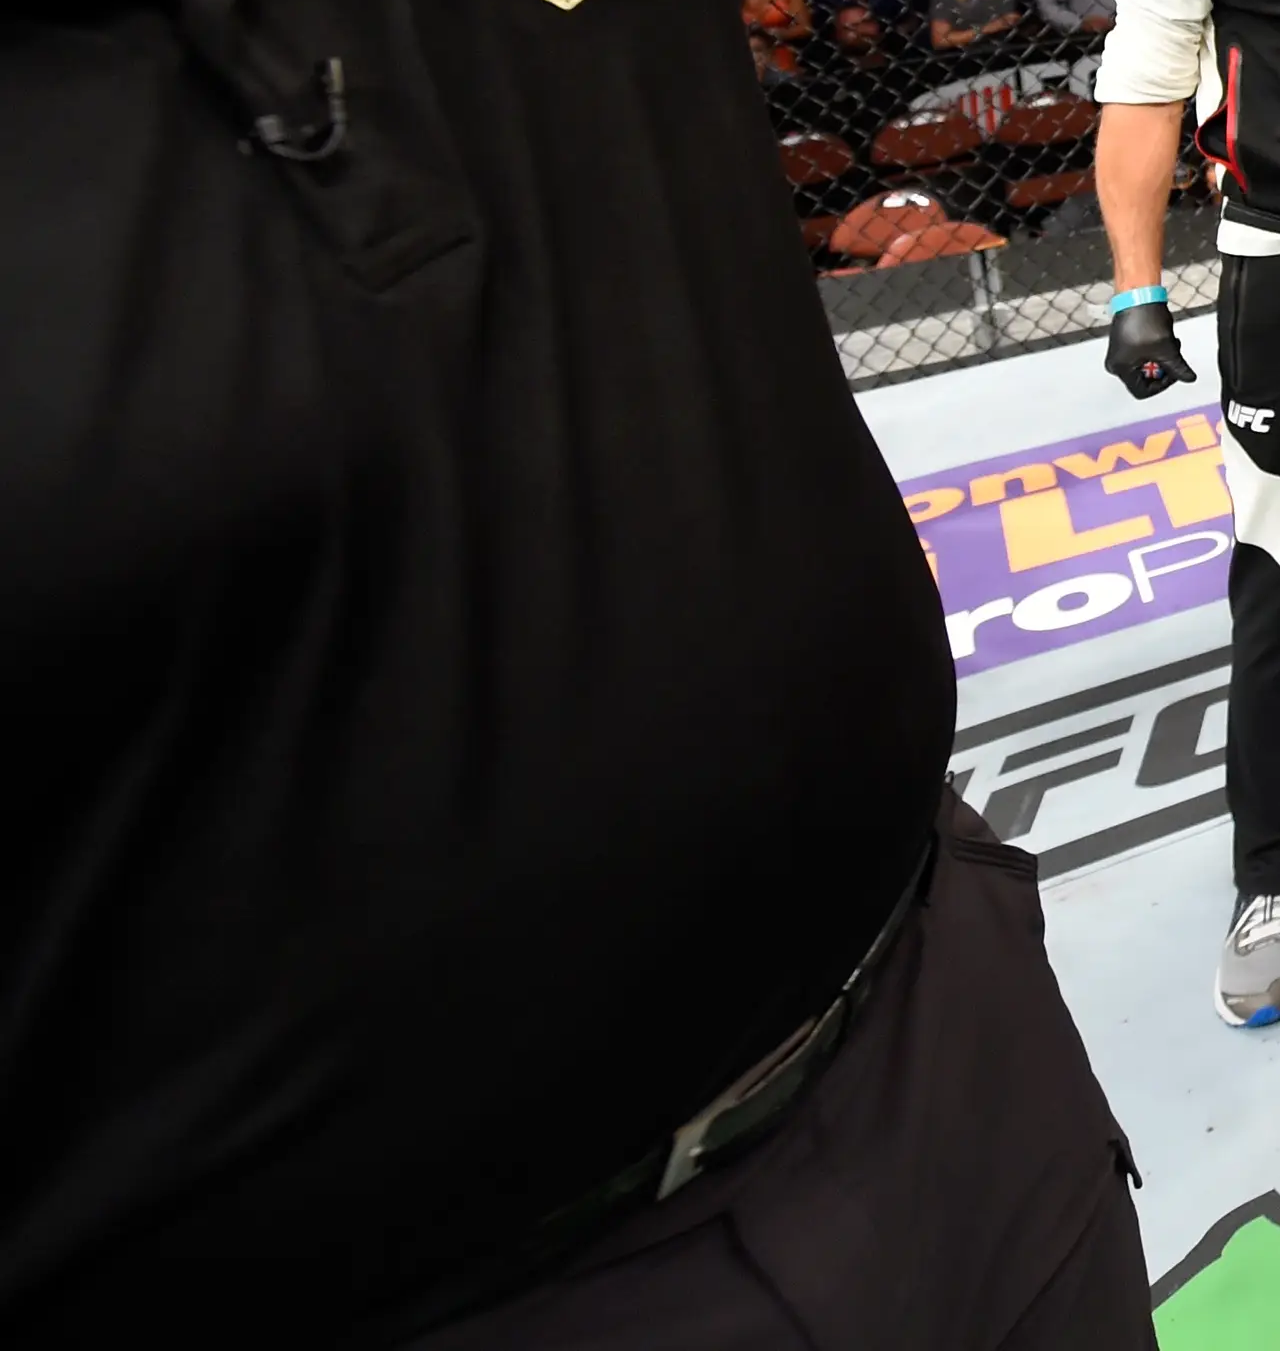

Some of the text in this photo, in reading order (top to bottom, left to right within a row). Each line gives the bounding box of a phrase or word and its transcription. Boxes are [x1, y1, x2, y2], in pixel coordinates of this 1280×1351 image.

[903, 413, 1222, 524] onwi
[1227, 399, 1275, 433] UFC
[944, 530, 1236, 661] roP
[945, 683, 1231, 843] FC
